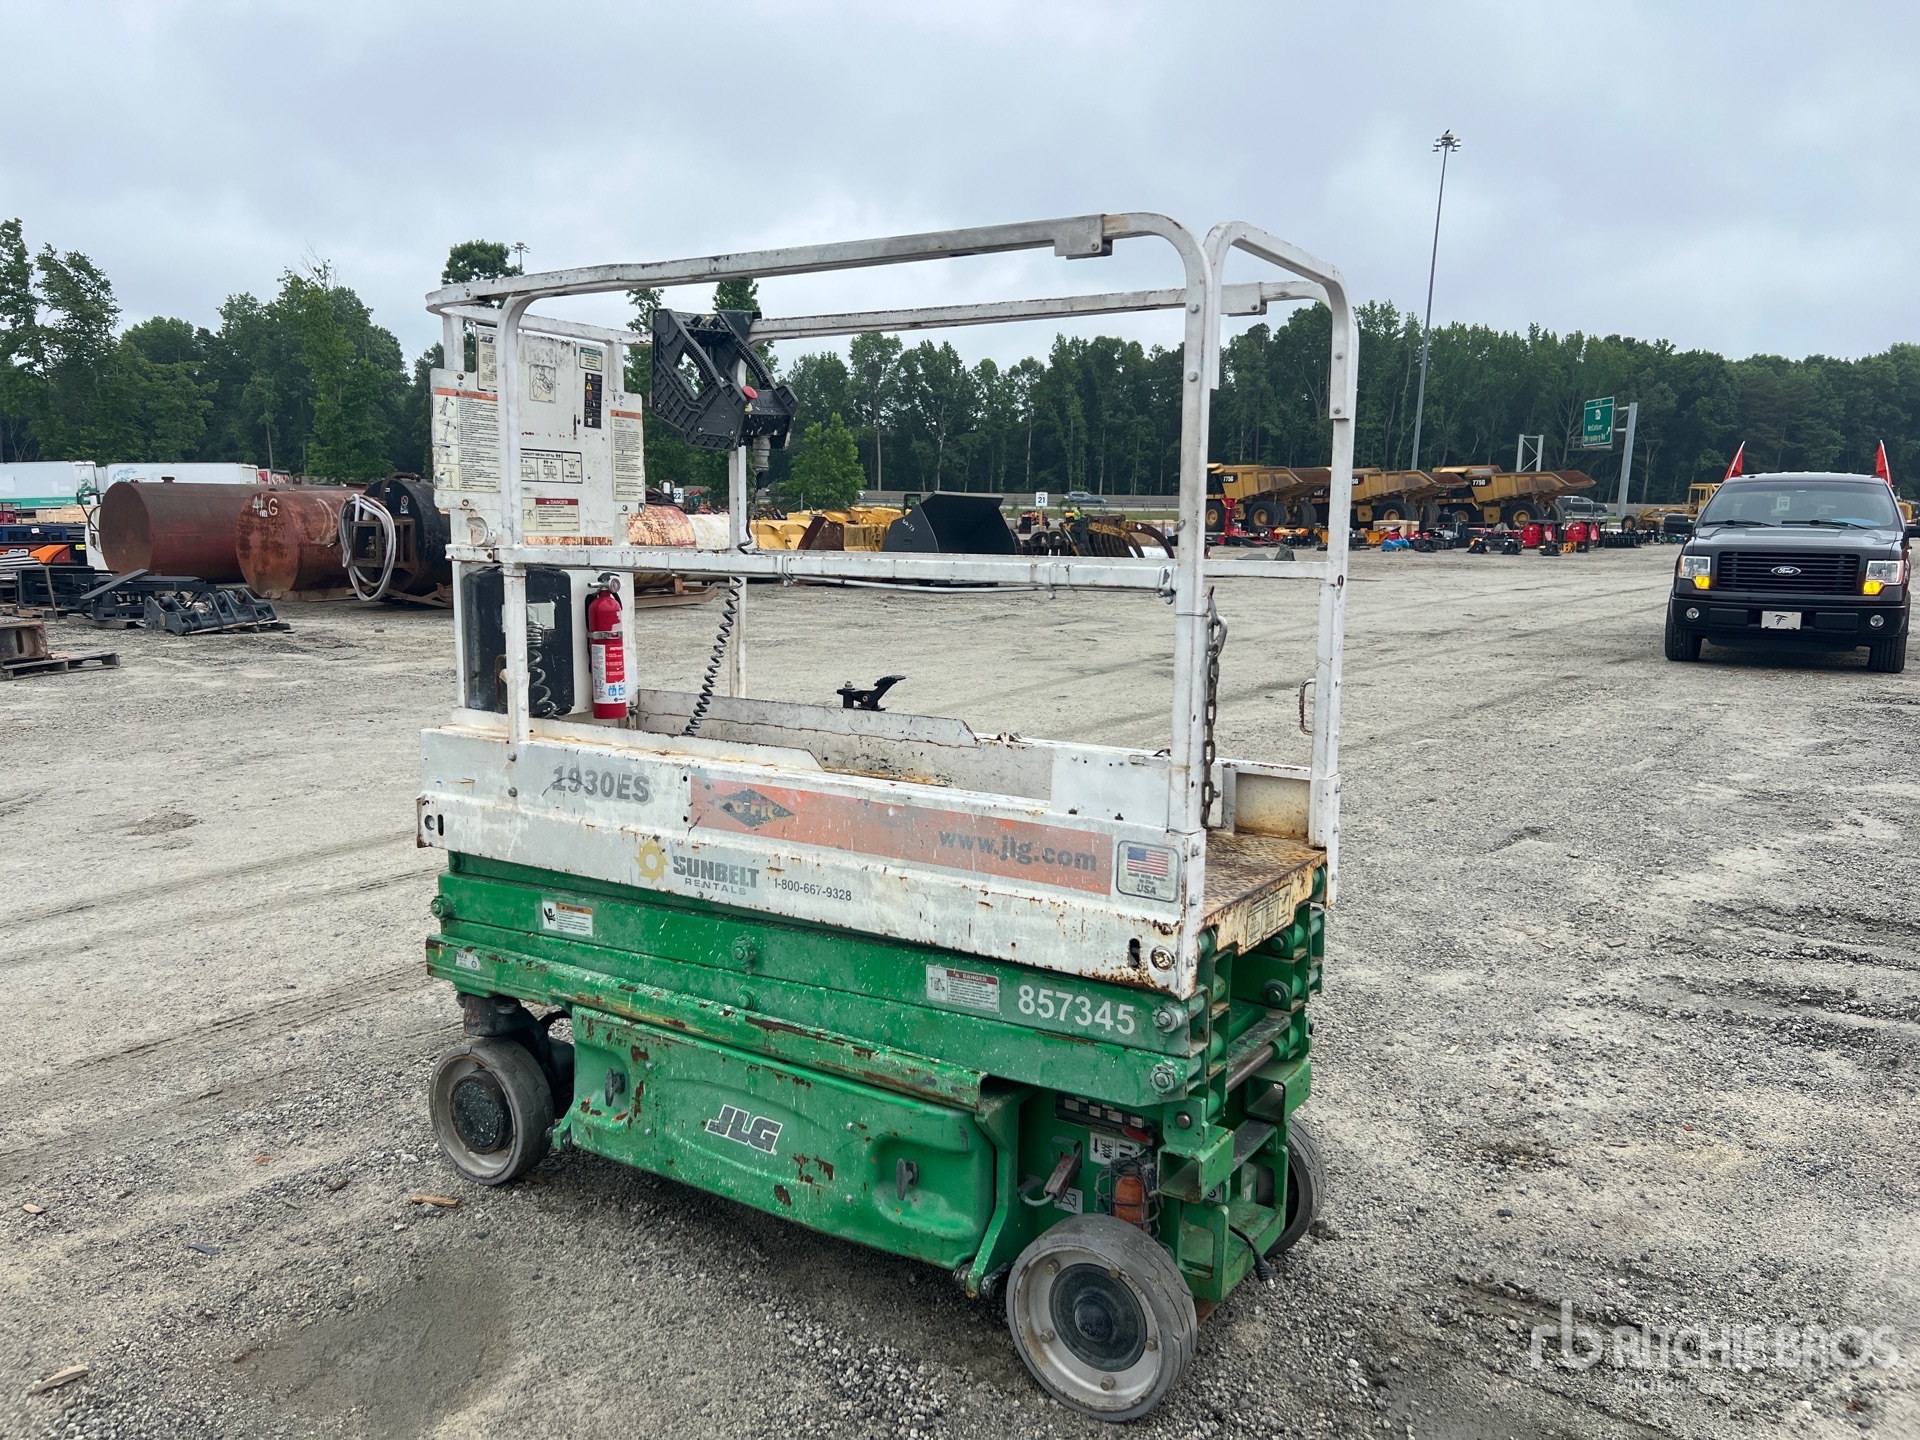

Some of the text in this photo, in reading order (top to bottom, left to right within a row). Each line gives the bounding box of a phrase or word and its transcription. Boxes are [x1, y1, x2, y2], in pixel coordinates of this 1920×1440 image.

[673, 492, 682, 500] 22
[1037, 496, 1046, 504] 21
[552, 765, 651, 803] 1930ES
[938, 830, 1098, 872] www.jlg.com
[672, 855, 760, 888] SUNBELT
[684, 877, 747, 896] RENTALS
[773, 877, 852, 902] 1-800-667-9328
[1136, 883, 1157, 895] USA
[962, 973, 987, 982] DANGER
[1018, 984, 1136, 1036] 857345
[704, 1103, 784, 1155] JLG
